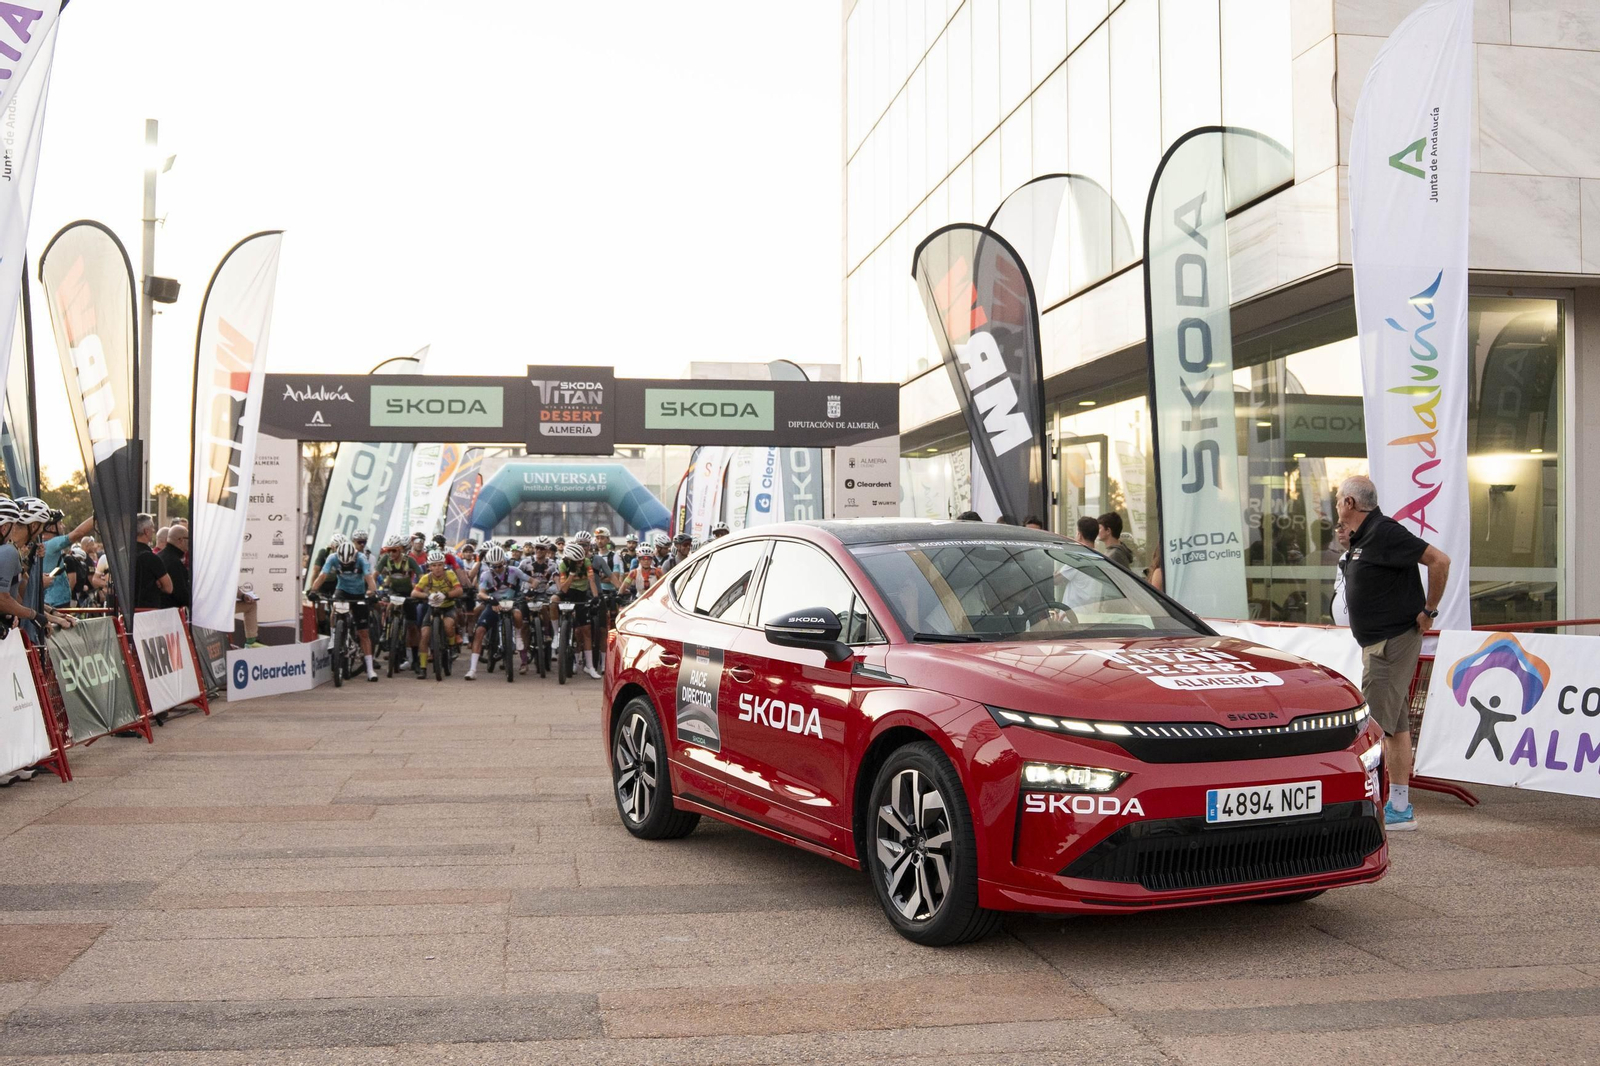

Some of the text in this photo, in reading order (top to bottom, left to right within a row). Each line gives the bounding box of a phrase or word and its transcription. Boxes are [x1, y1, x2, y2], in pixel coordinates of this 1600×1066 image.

[1429, 106, 1440, 203] Junta de Andalucía
[282, 383, 355, 403] Andalucía
[531, 379, 604, 405] TITAN
[1385, 268, 1444, 537] Andalucía
[540, 410, 603, 423] DESERT
[788, 420, 880, 429] DIPUTACIÓN DE ALMERÍA
[547, 424, 593, 434] ALMERÍA
[762, 446, 776, 489] Clear
[523, 472, 608, 484] UNIVERSAE
[523, 484, 607, 493] Instituto Superior de FP
[1249, 513, 1333, 530] SPORS
[1208, 549, 1242, 561] Cycling
[251, 660, 307, 681] Cleardent
[1127, 660, 1257, 675] DESERT
[689, 669, 709, 688] RACE
[1174, 674, 1269, 688] ALMERÍA
[681, 685, 713, 709] DIRECTOR
[1210, 785, 1316, 817] E 4894 NCF
